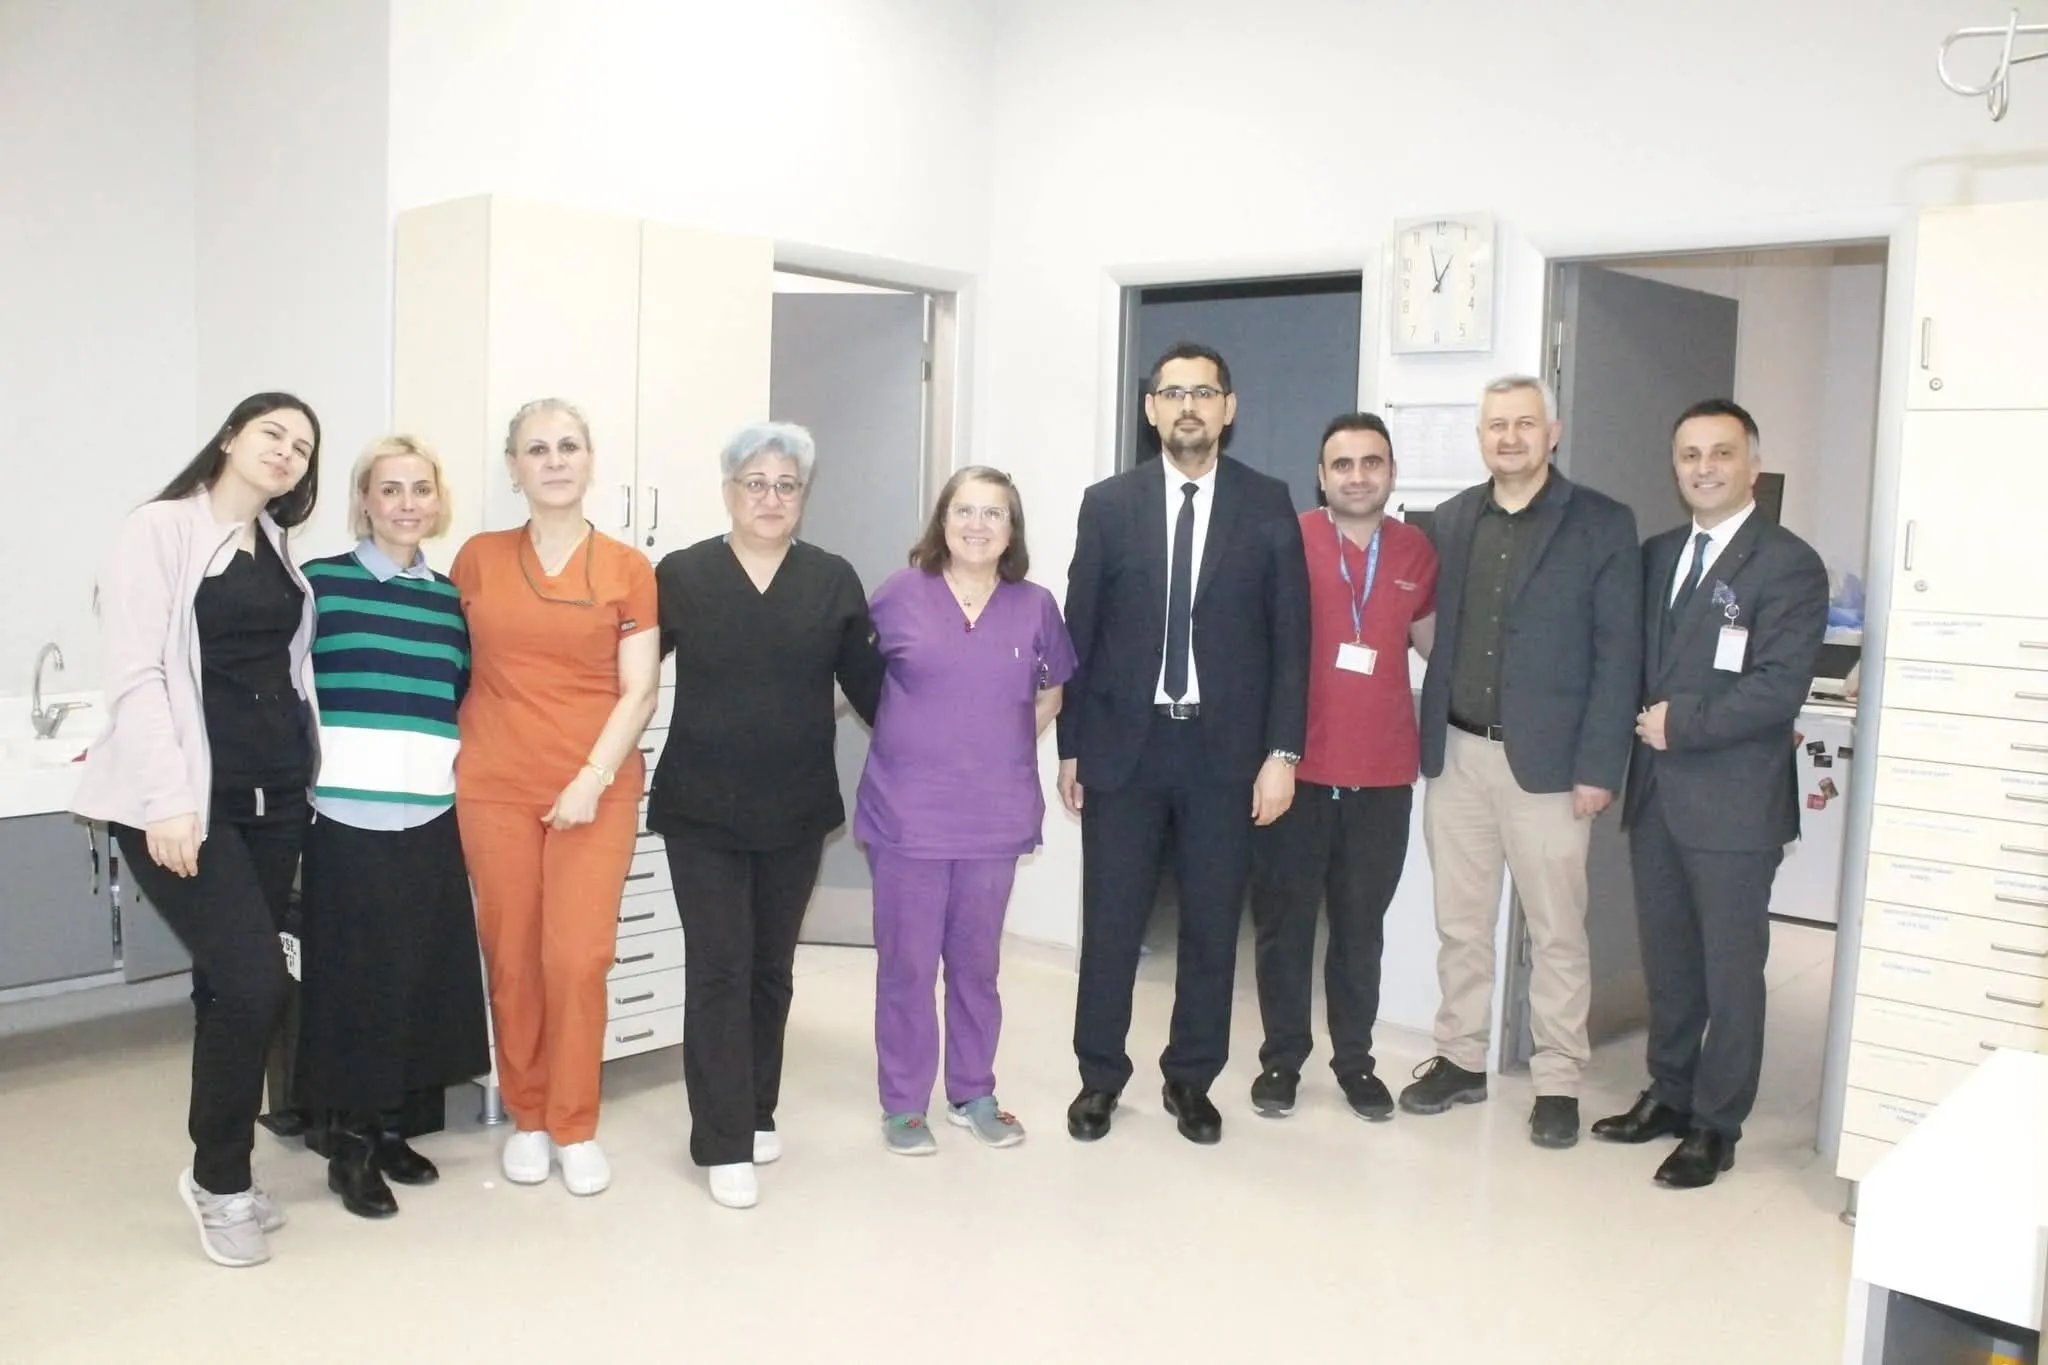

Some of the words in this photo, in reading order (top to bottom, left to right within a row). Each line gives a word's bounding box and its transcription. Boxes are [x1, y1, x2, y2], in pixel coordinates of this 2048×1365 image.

[1436, 220, 1447, 236] 12
[1403, 300, 1410, 314] 8
[1468, 296, 1475, 311] 4
[1408, 325, 1417, 339] 7
[1459, 322, 1466, 337] 5
